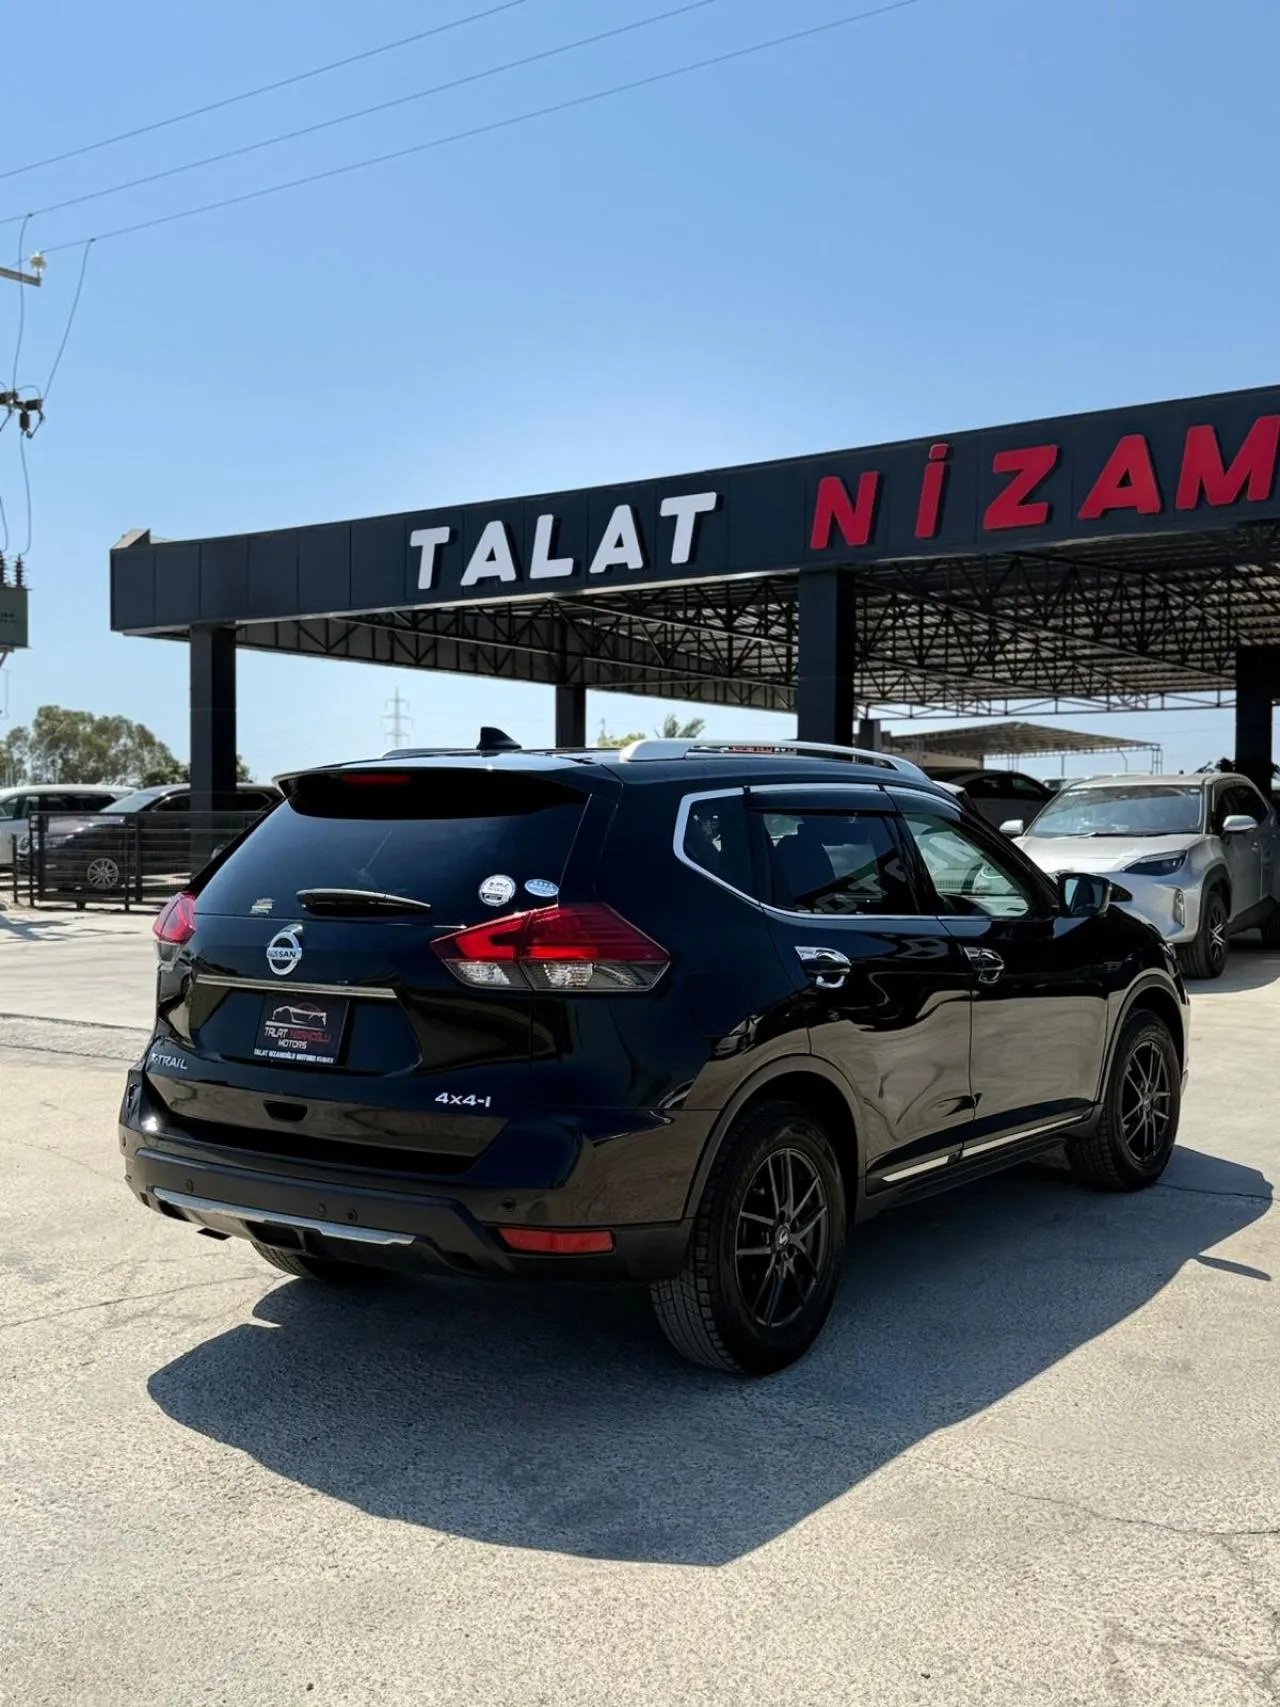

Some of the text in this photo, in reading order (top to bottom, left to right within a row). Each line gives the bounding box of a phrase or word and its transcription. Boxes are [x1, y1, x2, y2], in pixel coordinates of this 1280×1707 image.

[409, 491, 717, 591] TALAT
[268, 950, 297, 958] NISSAN
[264, 1027, 288, 1038] TALAT
[278, 1039, 308, 1050] MOTORS
